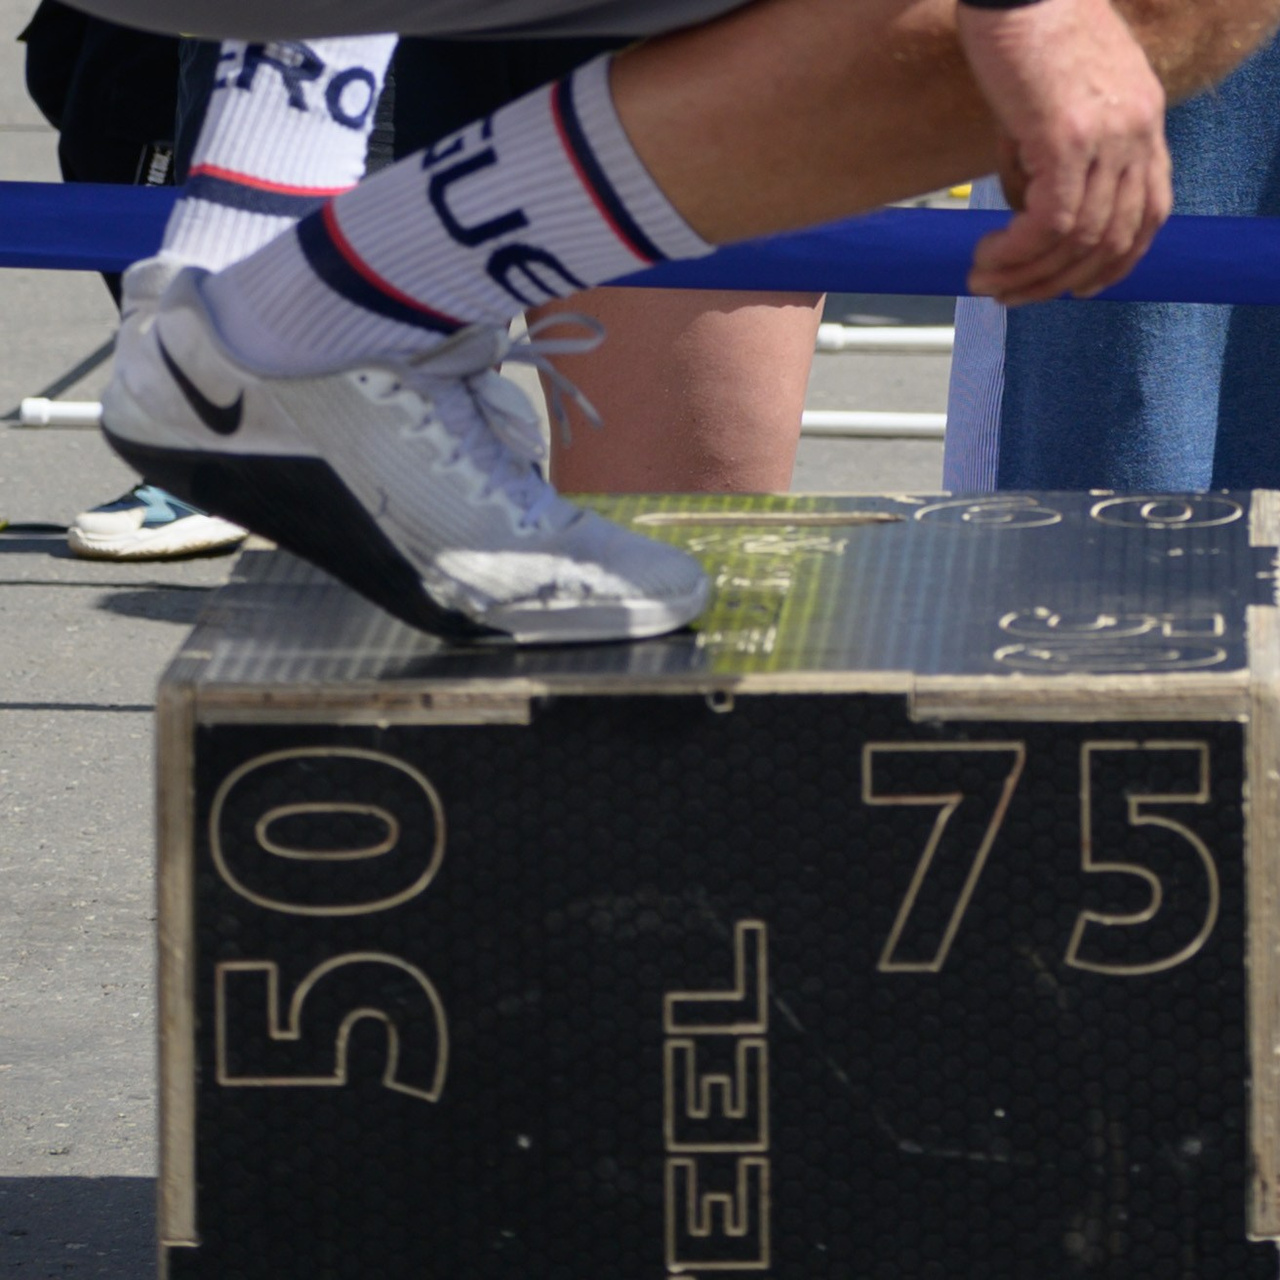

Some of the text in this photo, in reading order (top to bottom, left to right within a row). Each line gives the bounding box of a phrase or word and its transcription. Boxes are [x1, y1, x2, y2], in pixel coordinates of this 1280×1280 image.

[209, 745, 448, 1102] 50
[861, 742, 1220, 976] 75
[664, 920, 770, 1280] EEL
